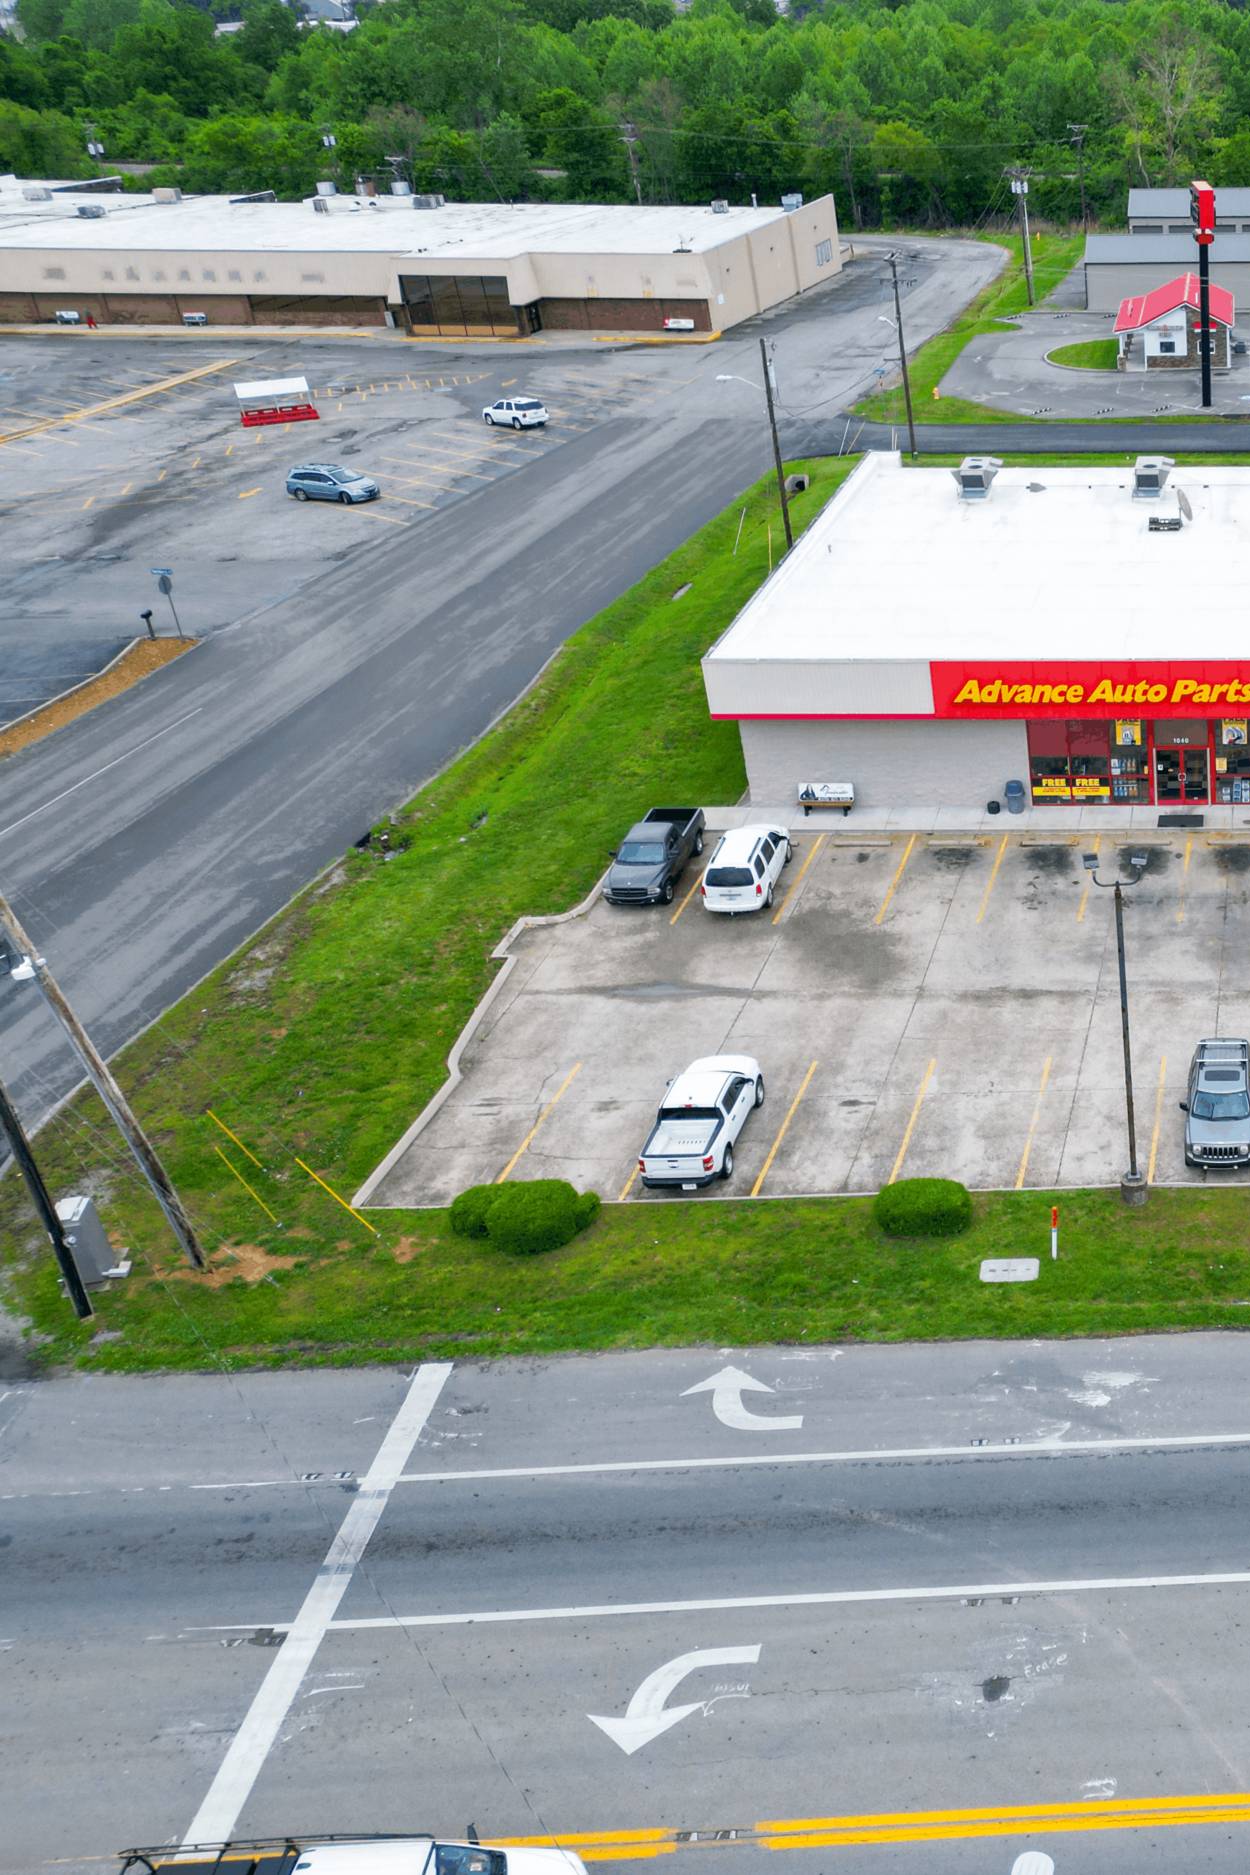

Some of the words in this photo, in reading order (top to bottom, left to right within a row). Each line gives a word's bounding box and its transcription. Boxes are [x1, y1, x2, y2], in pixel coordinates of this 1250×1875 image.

[954, 679, 1083, 704] Advance
[1087, 679, 1166, 704] Auto
[1042, 778, 1066, 787] FREE
[1075, 778, 1100, 787] FREE
